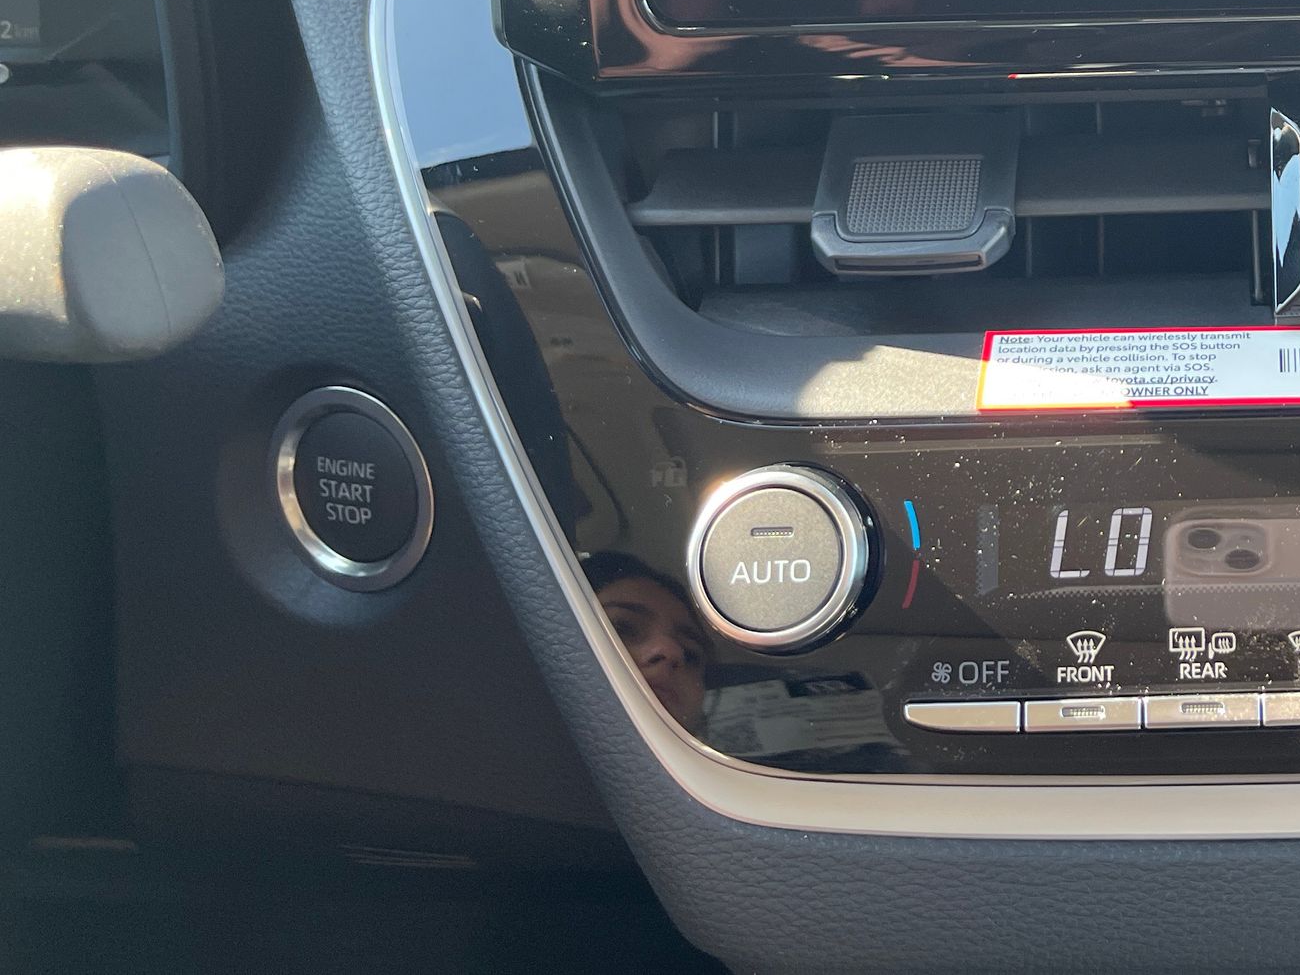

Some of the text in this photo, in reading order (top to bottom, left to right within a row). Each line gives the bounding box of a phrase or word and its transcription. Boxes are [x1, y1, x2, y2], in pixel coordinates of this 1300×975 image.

[1000, 331, 1251, 344] Note: Your vehicle can wirelessly transmit
[998, 342, 1240, 354] location data by pressing the SOS button
[1011, 355, 1053, 365] during
[1067, 355, 1110, 363] vehicle
[1113, 353, 1168, 362] collision.
[1172, 353, 1185, 361] To
[1189, 353, 1216, 362] stop
[1081, 365, 1103, 373] ask
[1124, 365, 1160, 374] agent
[1163, 364, 1181, 372] via
[1184, 363, 1214, 371] SOS.
[1105, 374, 1218, 385] toyota.ca/privacy.
[1174, 385, 1208, 396] ONLY
[317, 456, 376, 480] ENGINE
[319, 478, 374, 503] START
[326, 502, 372, 525] STOP
[730, 559, 811, 585] AUTO
[958, 660, 1010, 685] OFF
[1057, 665, 1115, 683] FRONT
[1180, 662, 1227, 679] REAR
